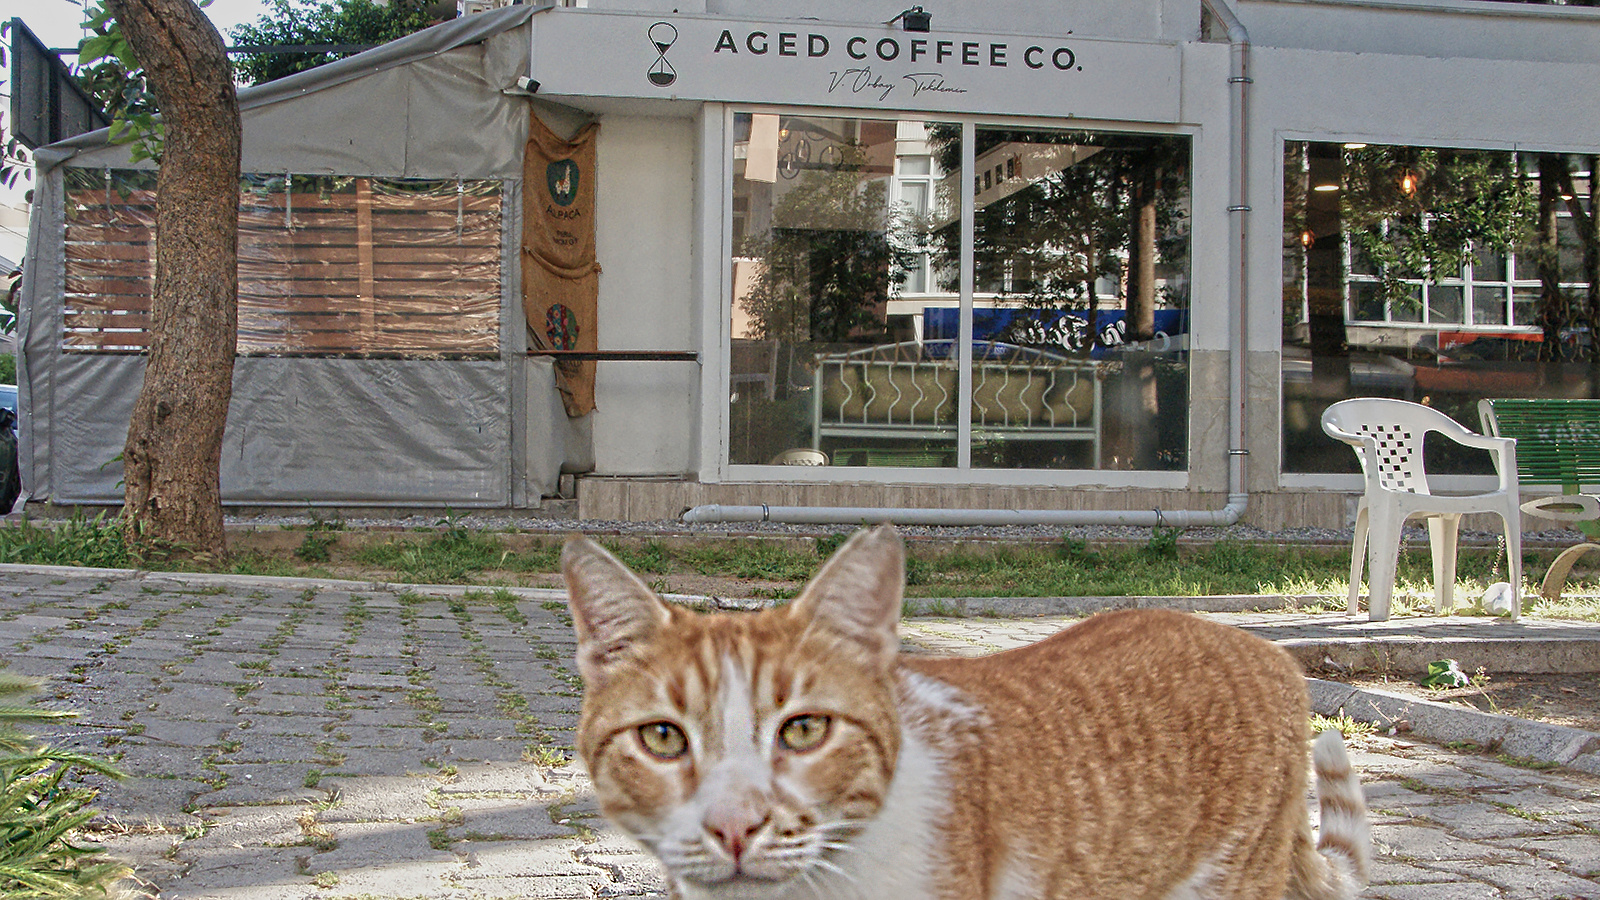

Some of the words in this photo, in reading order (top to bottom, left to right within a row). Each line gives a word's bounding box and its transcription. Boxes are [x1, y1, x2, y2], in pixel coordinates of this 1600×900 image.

[713, 30, 830, 58] AGED
[846, 37, 1008, 68] COFFEE
[1023, 46, 1084, 73] CO.
[545, 204, 581, 221] ALPACA
